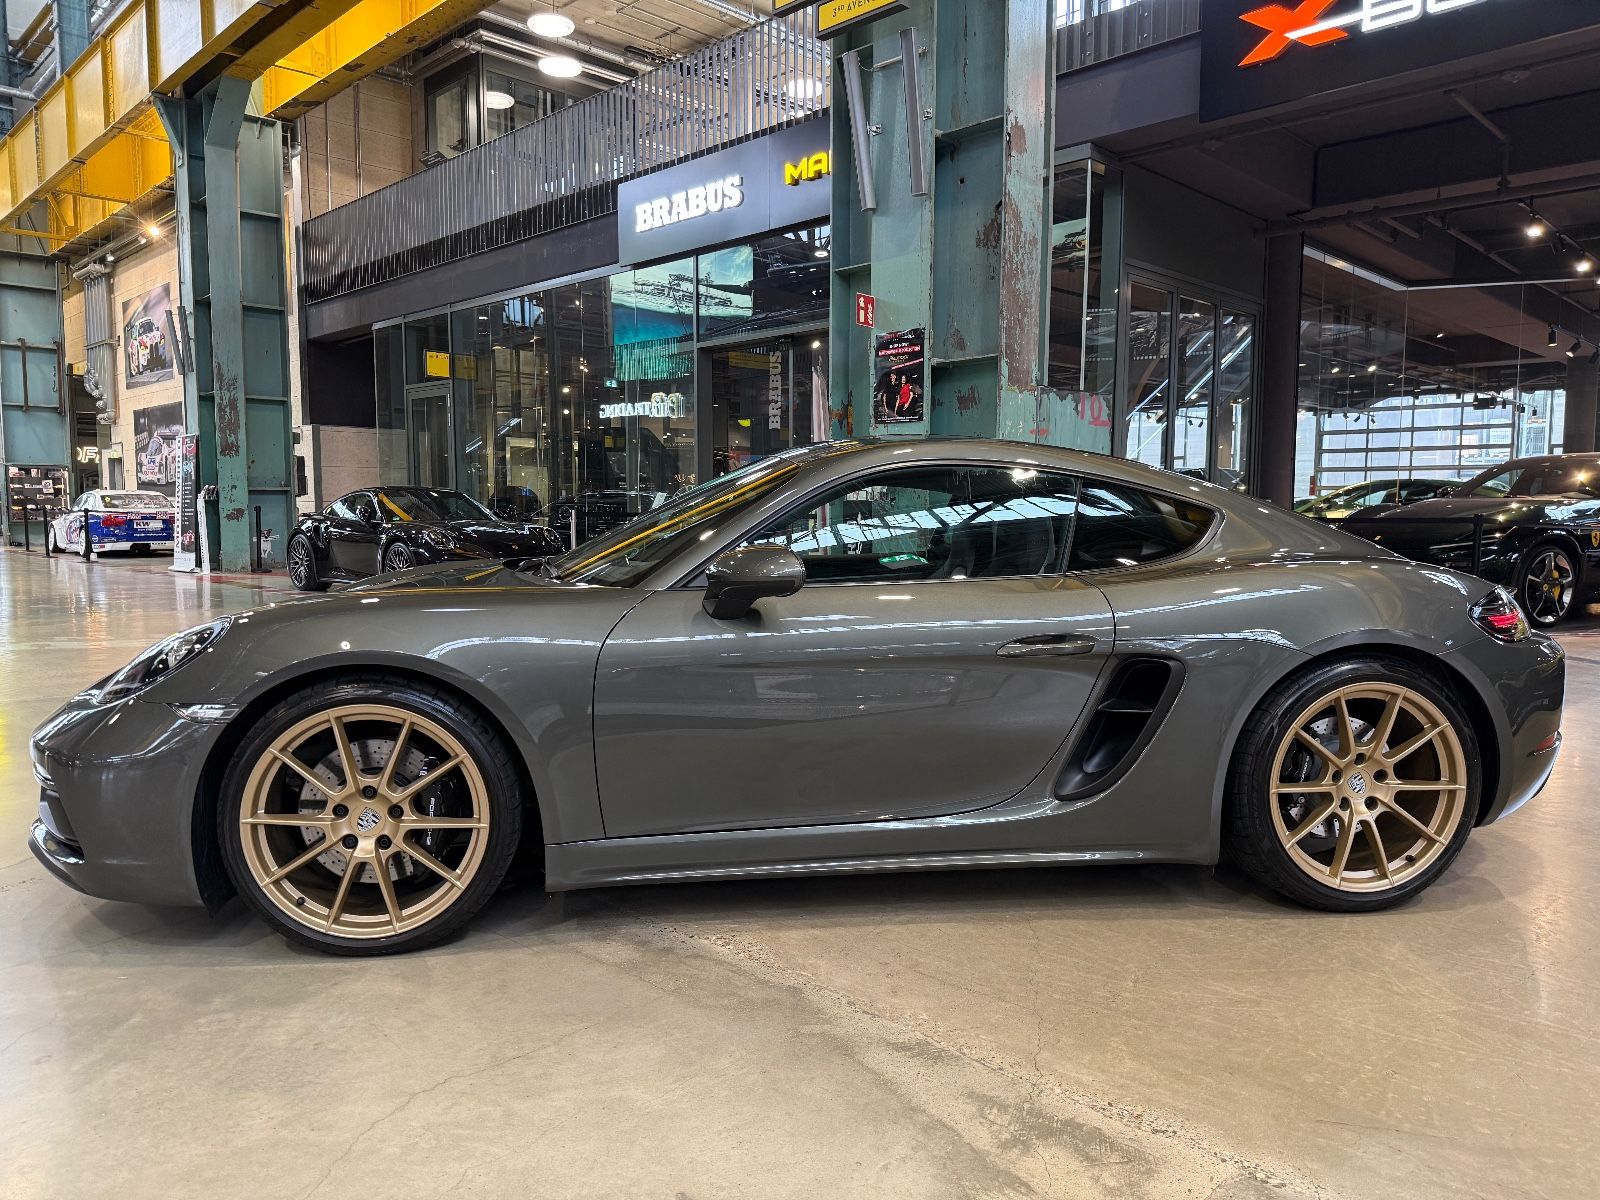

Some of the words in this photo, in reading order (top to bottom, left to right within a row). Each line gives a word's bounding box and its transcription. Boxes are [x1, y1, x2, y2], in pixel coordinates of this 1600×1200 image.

[784, 149, 832, 185] MA
[635, 175, 744, 233] BRABUS
[768, 351, 782, 430] BRABUS
